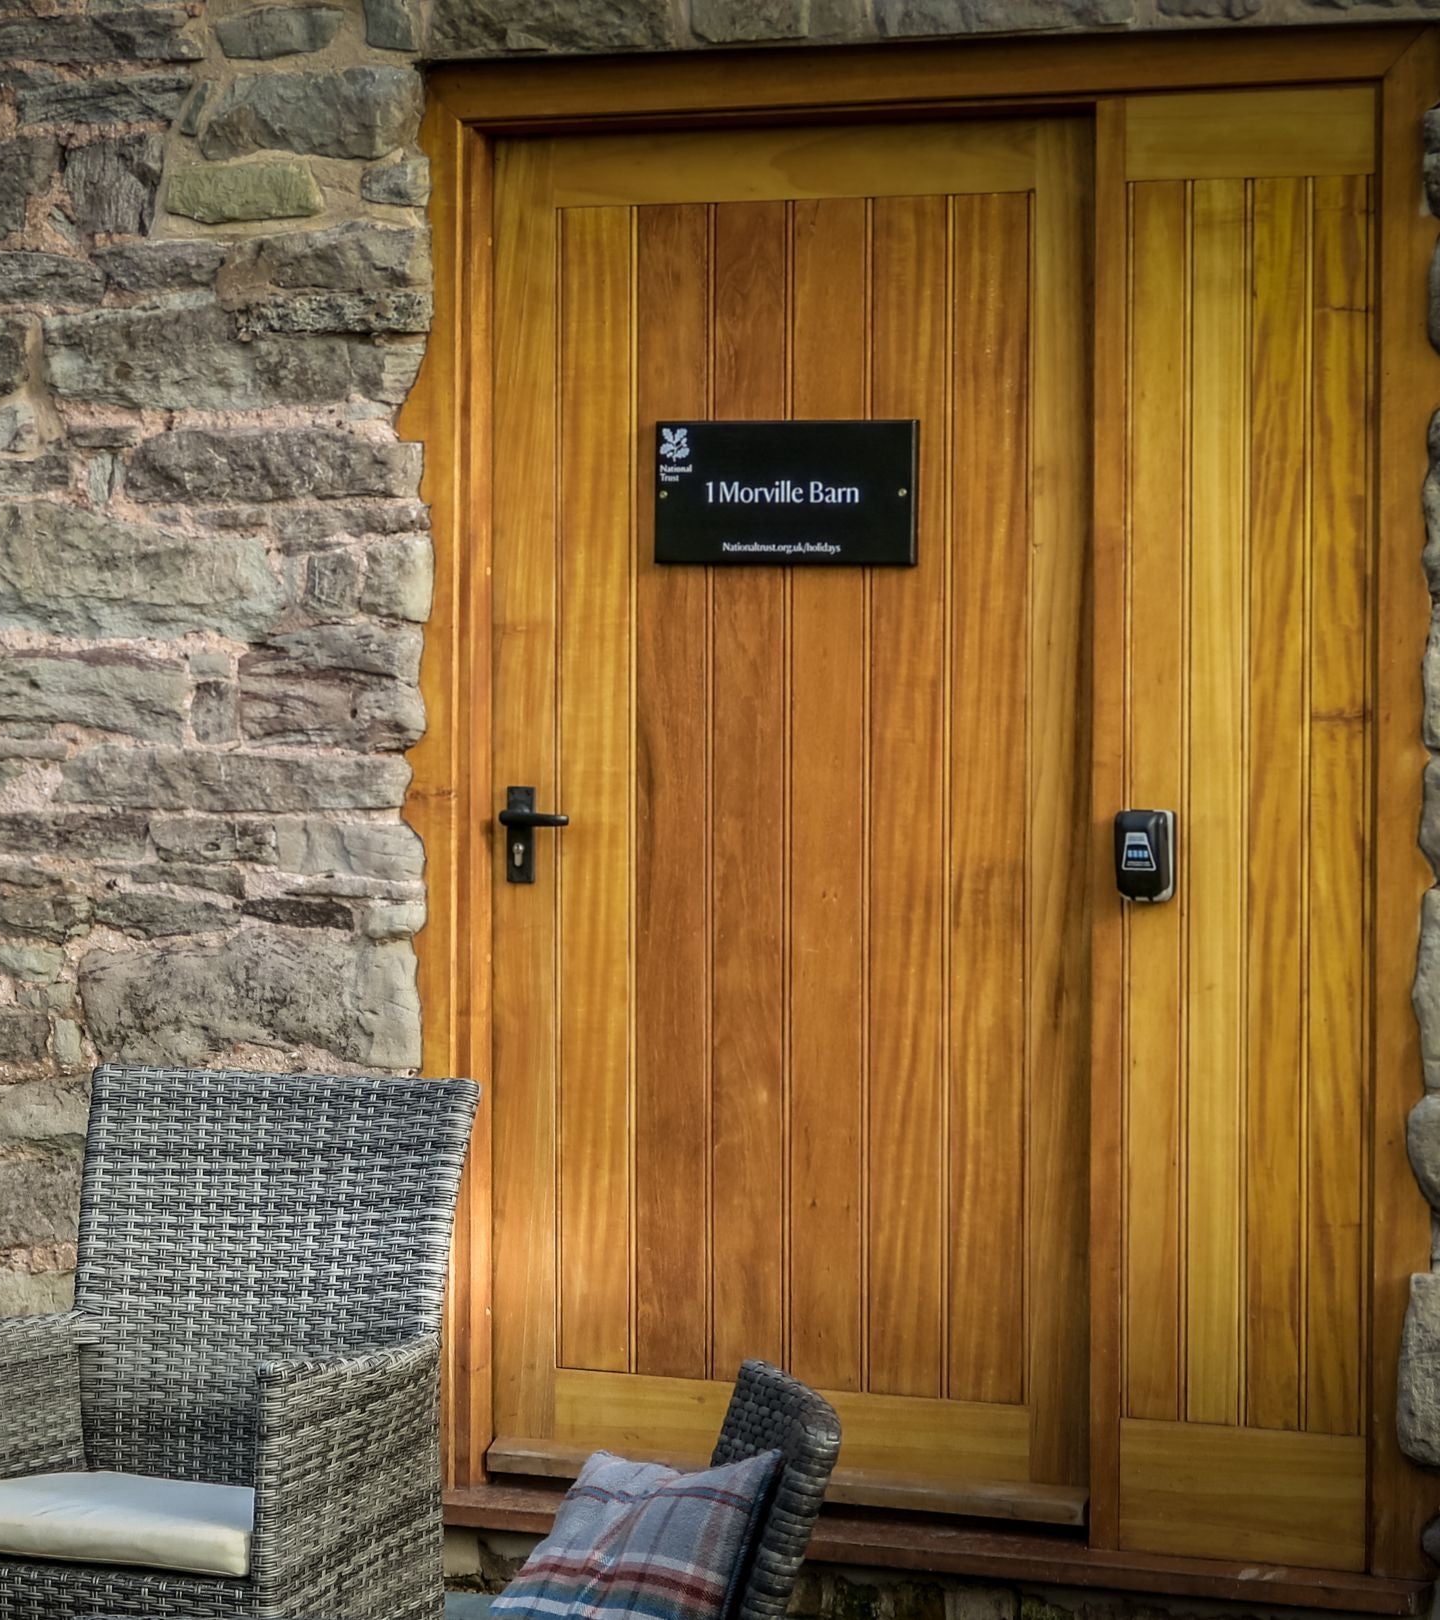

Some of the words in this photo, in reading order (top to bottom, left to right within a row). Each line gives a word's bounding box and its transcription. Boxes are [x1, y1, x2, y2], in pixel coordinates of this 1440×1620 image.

[659, 464, 693, 473] National
[659, 473, 680, 482] Trust
[705, 481, 714, 503] 1
[719, 480, 804, 503] Morville
[810, 481, 860, 503] Barn
[722, 541, 841, 555] Nationaltrust.org.uk/holidays
